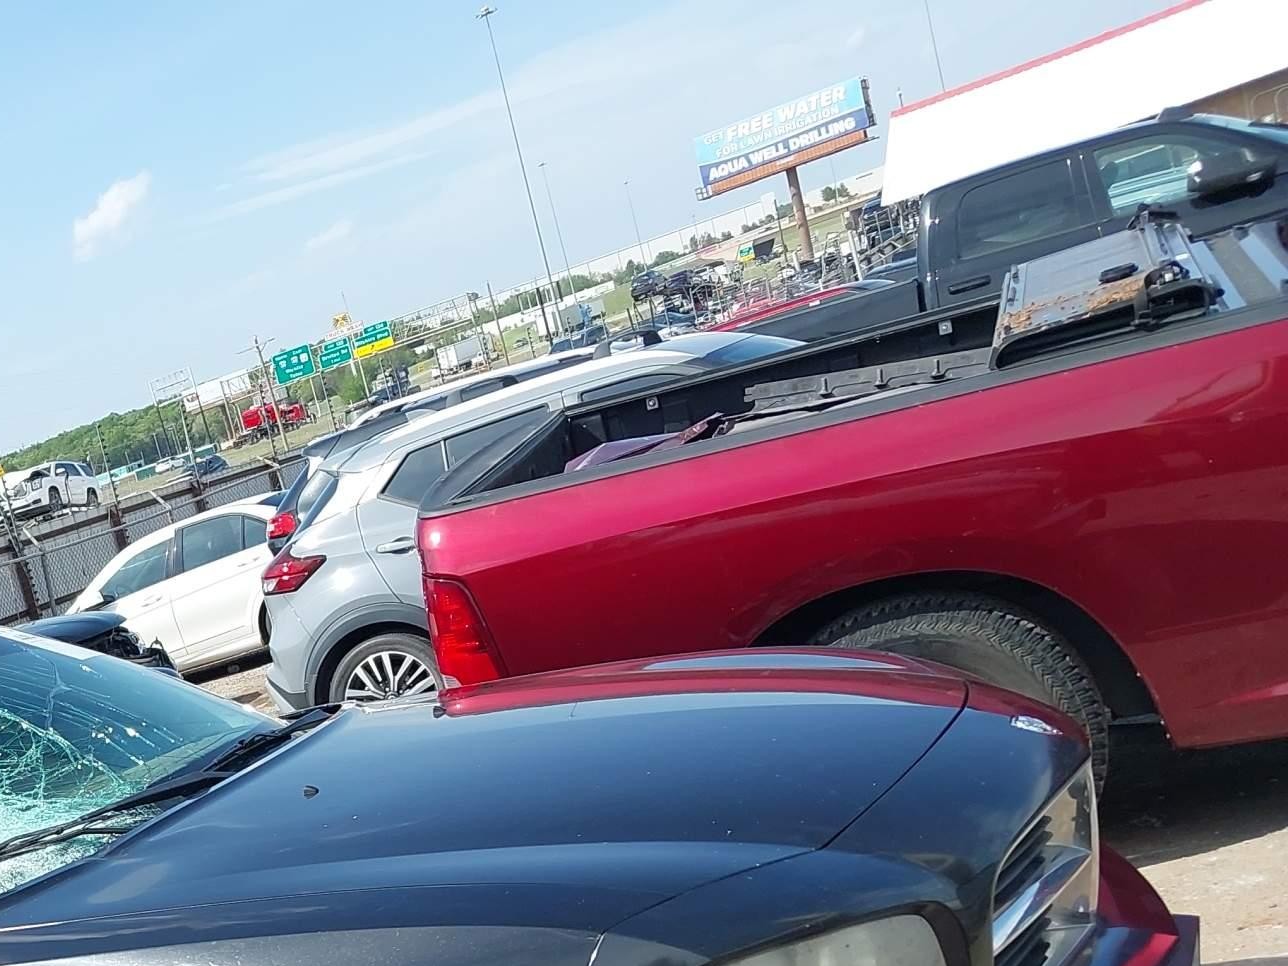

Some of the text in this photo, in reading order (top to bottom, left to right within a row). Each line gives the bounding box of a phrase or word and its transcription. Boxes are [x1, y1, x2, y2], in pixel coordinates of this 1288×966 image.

[703, 85, 847, 145] GET FREE WATER
[716, 105, 840, 158] FOR LAWN IRRIGATION
[709, 157, 750, 181] AQUA
[748, 142, 790, 164] WELL
[788, 117, 856, 149] DRILLING
